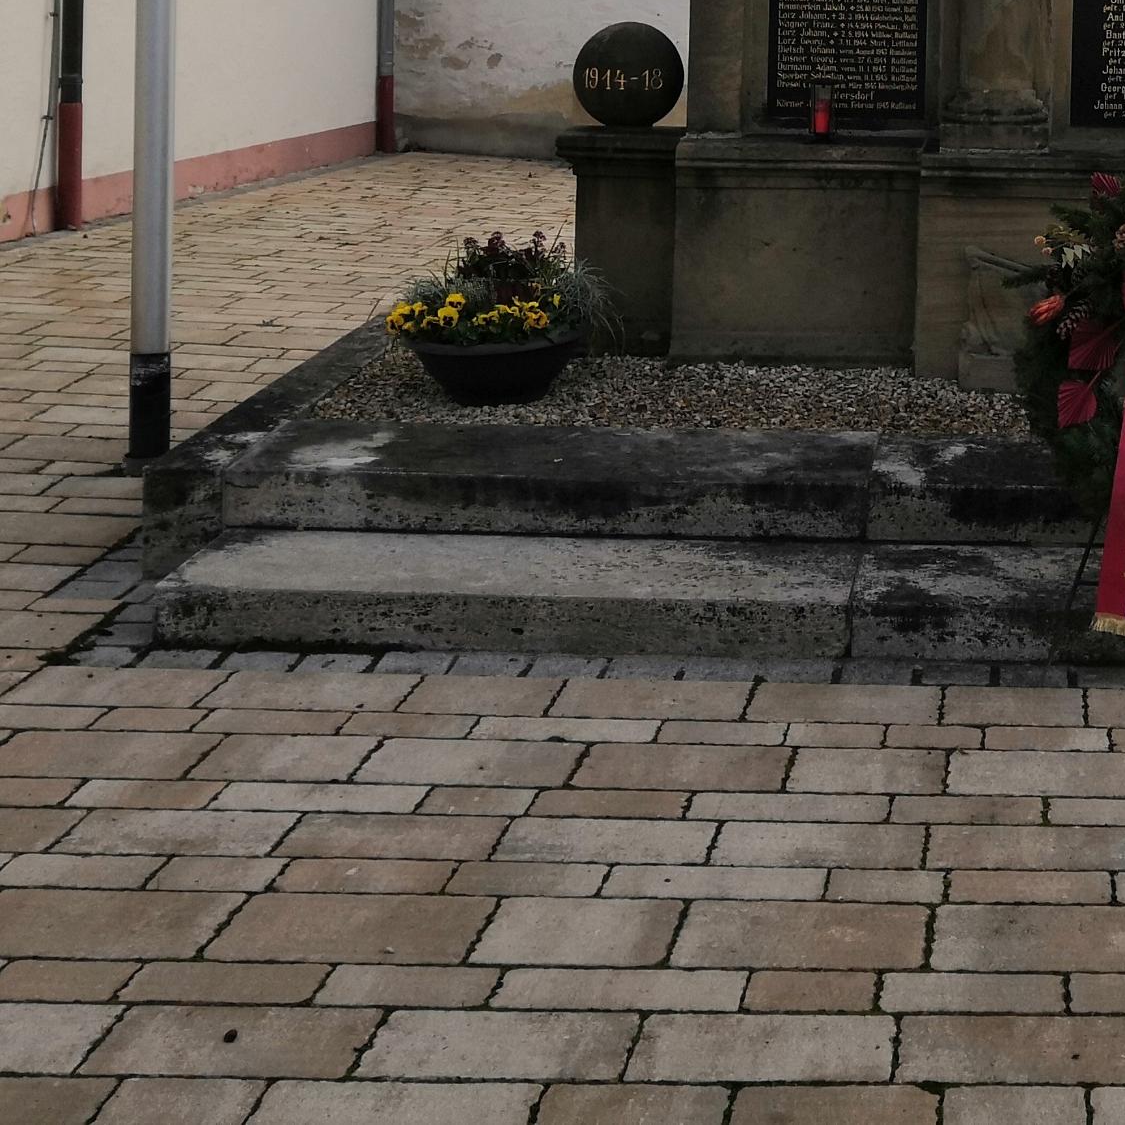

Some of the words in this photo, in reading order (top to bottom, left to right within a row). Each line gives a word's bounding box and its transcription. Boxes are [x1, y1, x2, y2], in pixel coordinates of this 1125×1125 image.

[584, 68, 663, 91] 1914-18
[1101, 83, 1125, 93] Georg
[1094, 100, 1122, 109] Johann
